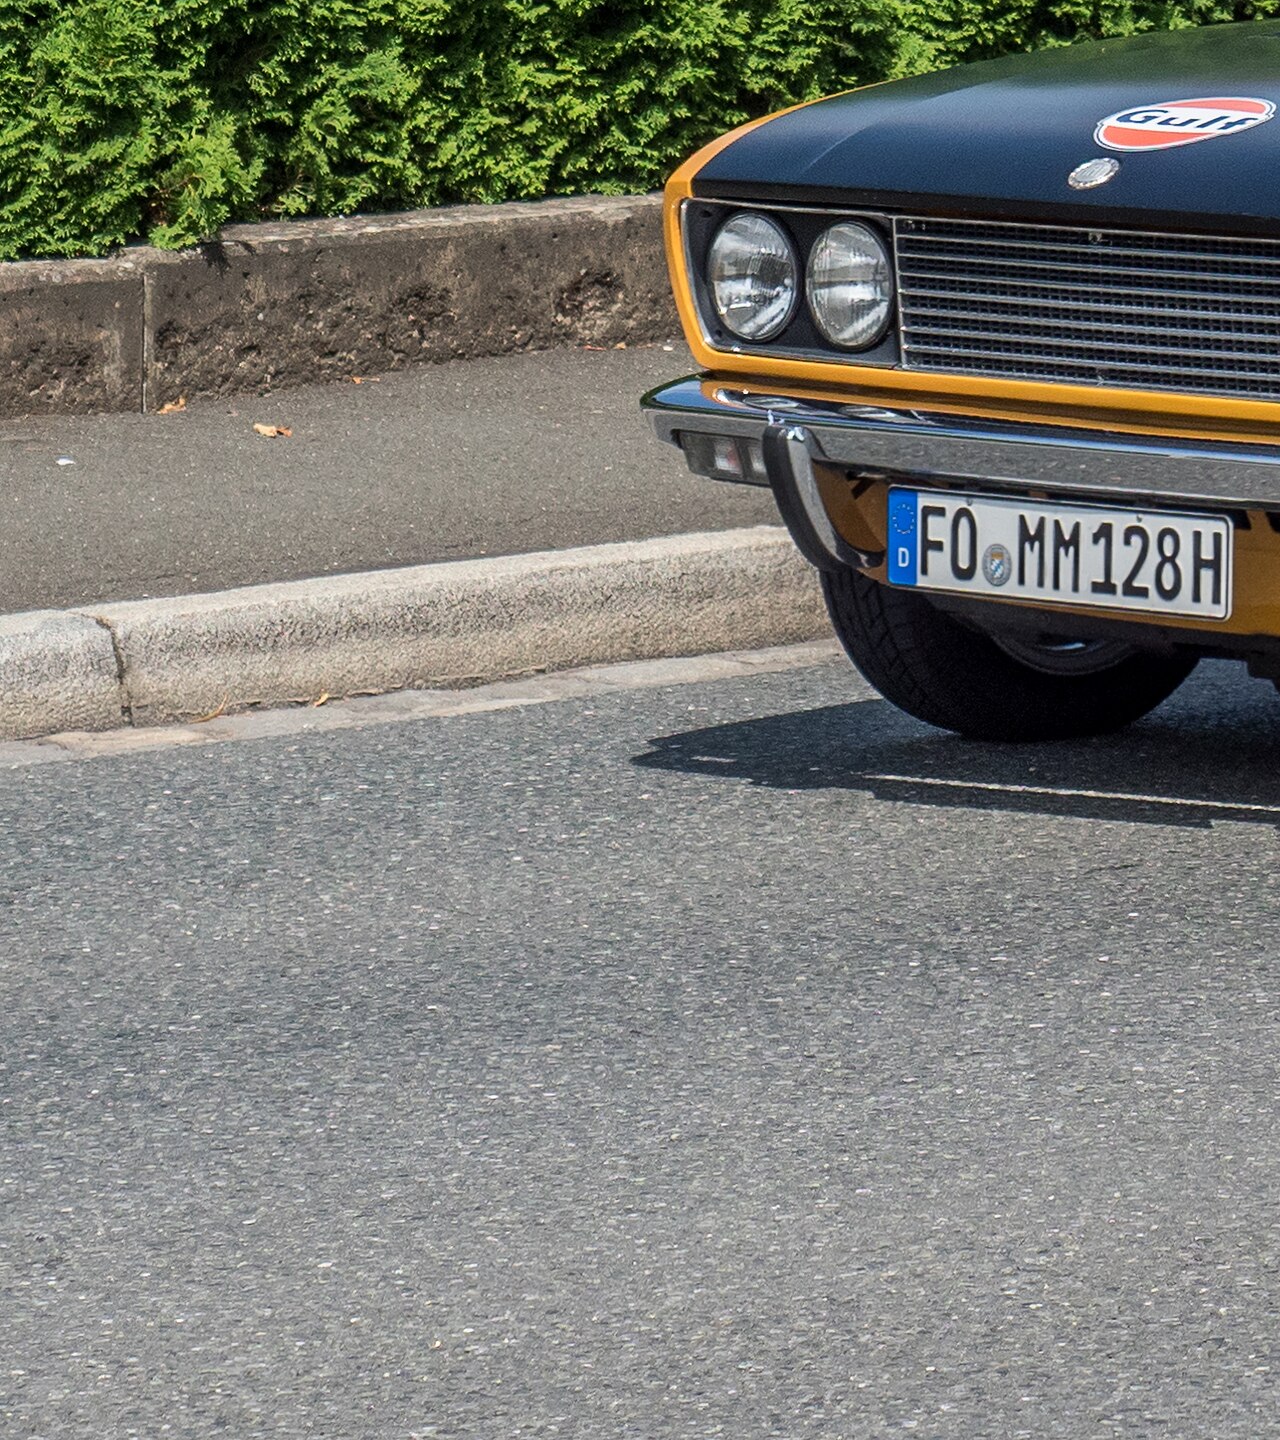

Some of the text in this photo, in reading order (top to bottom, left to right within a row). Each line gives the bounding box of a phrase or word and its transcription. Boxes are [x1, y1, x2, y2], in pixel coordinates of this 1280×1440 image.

[1115, 109, 1259, 131] Gulf
[920, 505, 977, 581] FO
[898, 548, 909, 568] D
